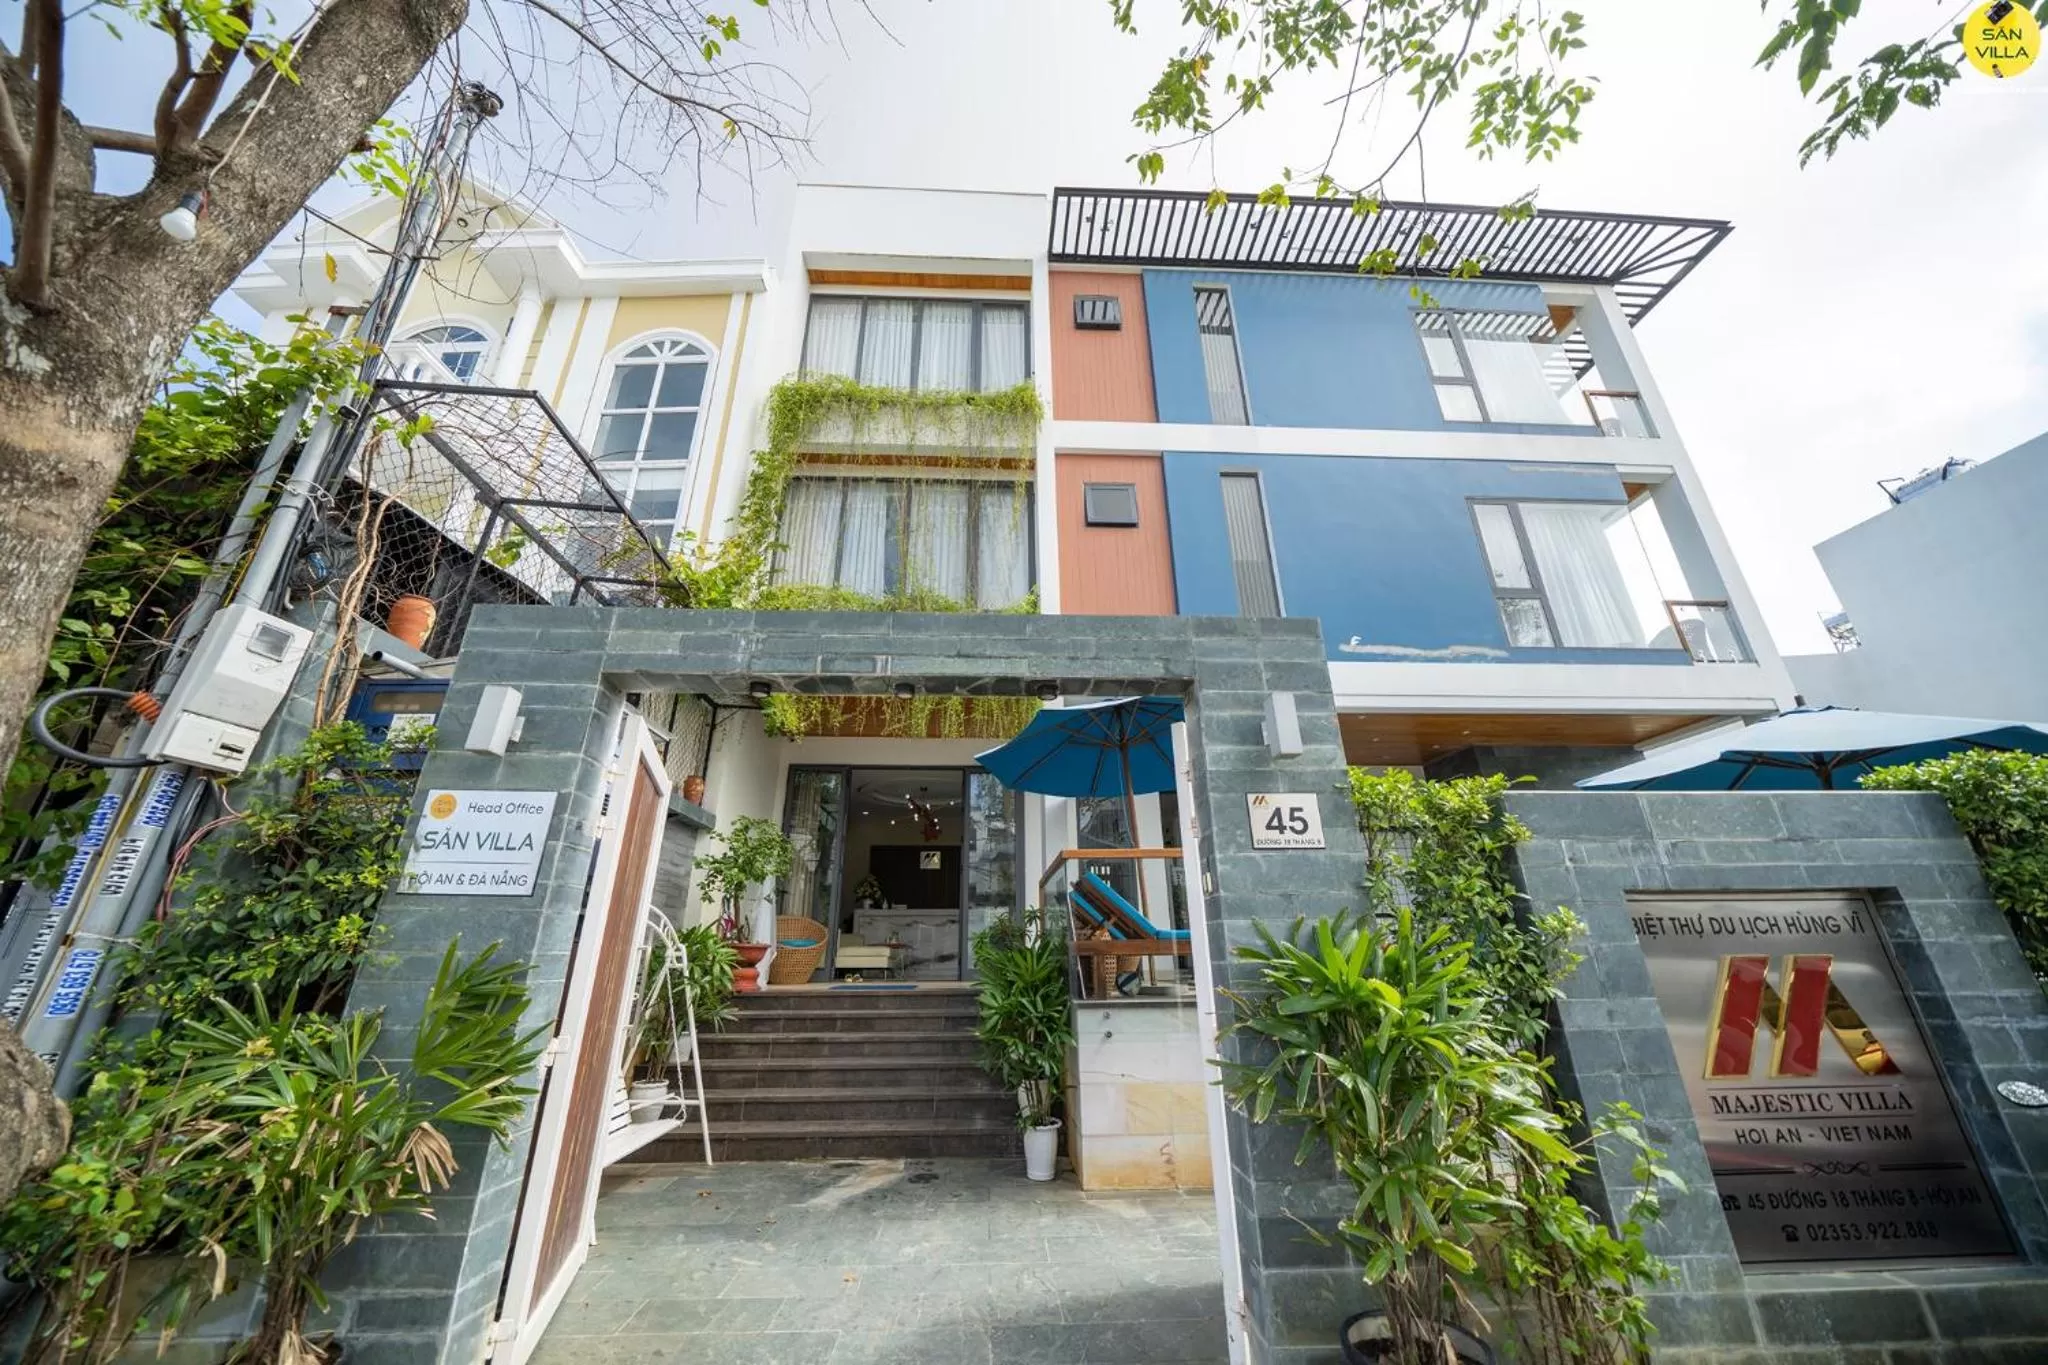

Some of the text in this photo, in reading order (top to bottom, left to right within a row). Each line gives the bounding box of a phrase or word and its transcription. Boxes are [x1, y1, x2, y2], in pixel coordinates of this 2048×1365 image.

[468, 801, 502, 814] Head
[505, 802, 544, 815] Office
[1265, 806, 1309, 835] 45
[420, 827, 534, 851] SĂN VILLA
[434, 873, 454, 885] AN
[456, 873, 466, 885] &
[1668, 914, 1704, 938] THỰ
[1708, 917, 1736, 935] DU
[1740, 917, 1783, 938] LỊCH
[1783, 911, 1842, 934] HÙNG
[1710, 1090, 1913, 1114] MAJESTIC VILLA
[1734, 1127, 1769, 1145] HOI
[1775, 1127, 1802, 1144] AN
[1819, 1126, 1864, 1143] VIET
[1866, 1124, 1914, 1143] NAM
[1748, 1193, 1765, 1211] 45
[1833, 1190, 1850, 1208] 18
[1806, 1222, 1939, 1242] 02353.922.888
